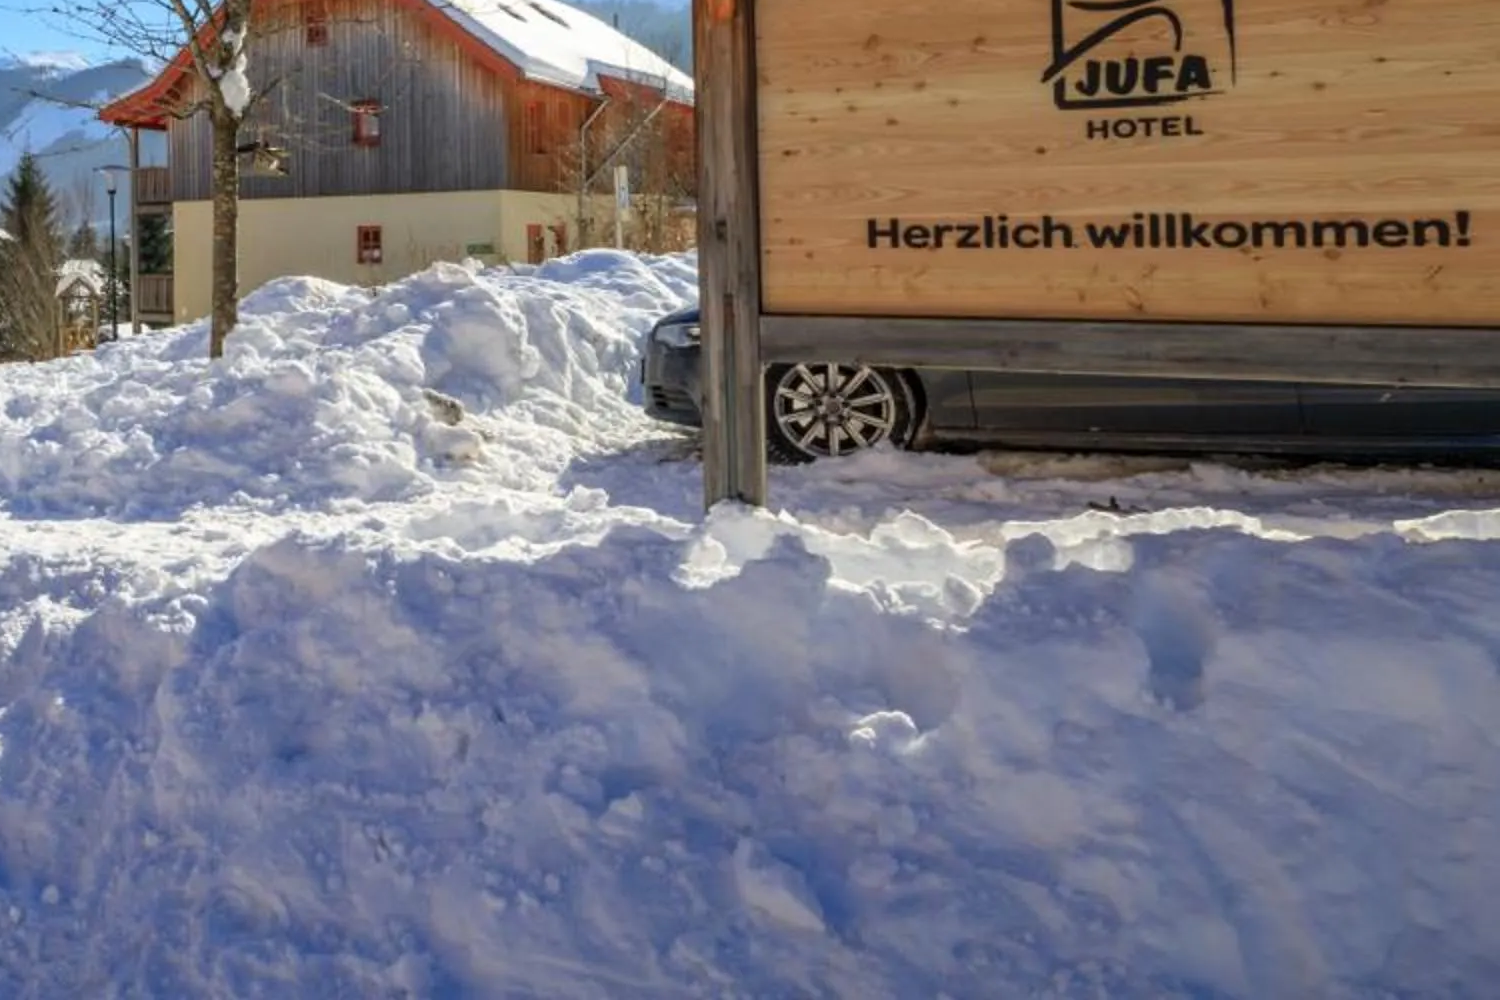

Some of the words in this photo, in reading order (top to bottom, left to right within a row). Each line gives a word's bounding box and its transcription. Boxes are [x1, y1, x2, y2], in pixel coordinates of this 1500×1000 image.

[1074, 54, 1212, 96] JUFA
[1086, 116, 1204, 139] HOTEL
[867, 215, 1074, 249] Herzlich
[1085, 210, 1472, 249] willkommen!
